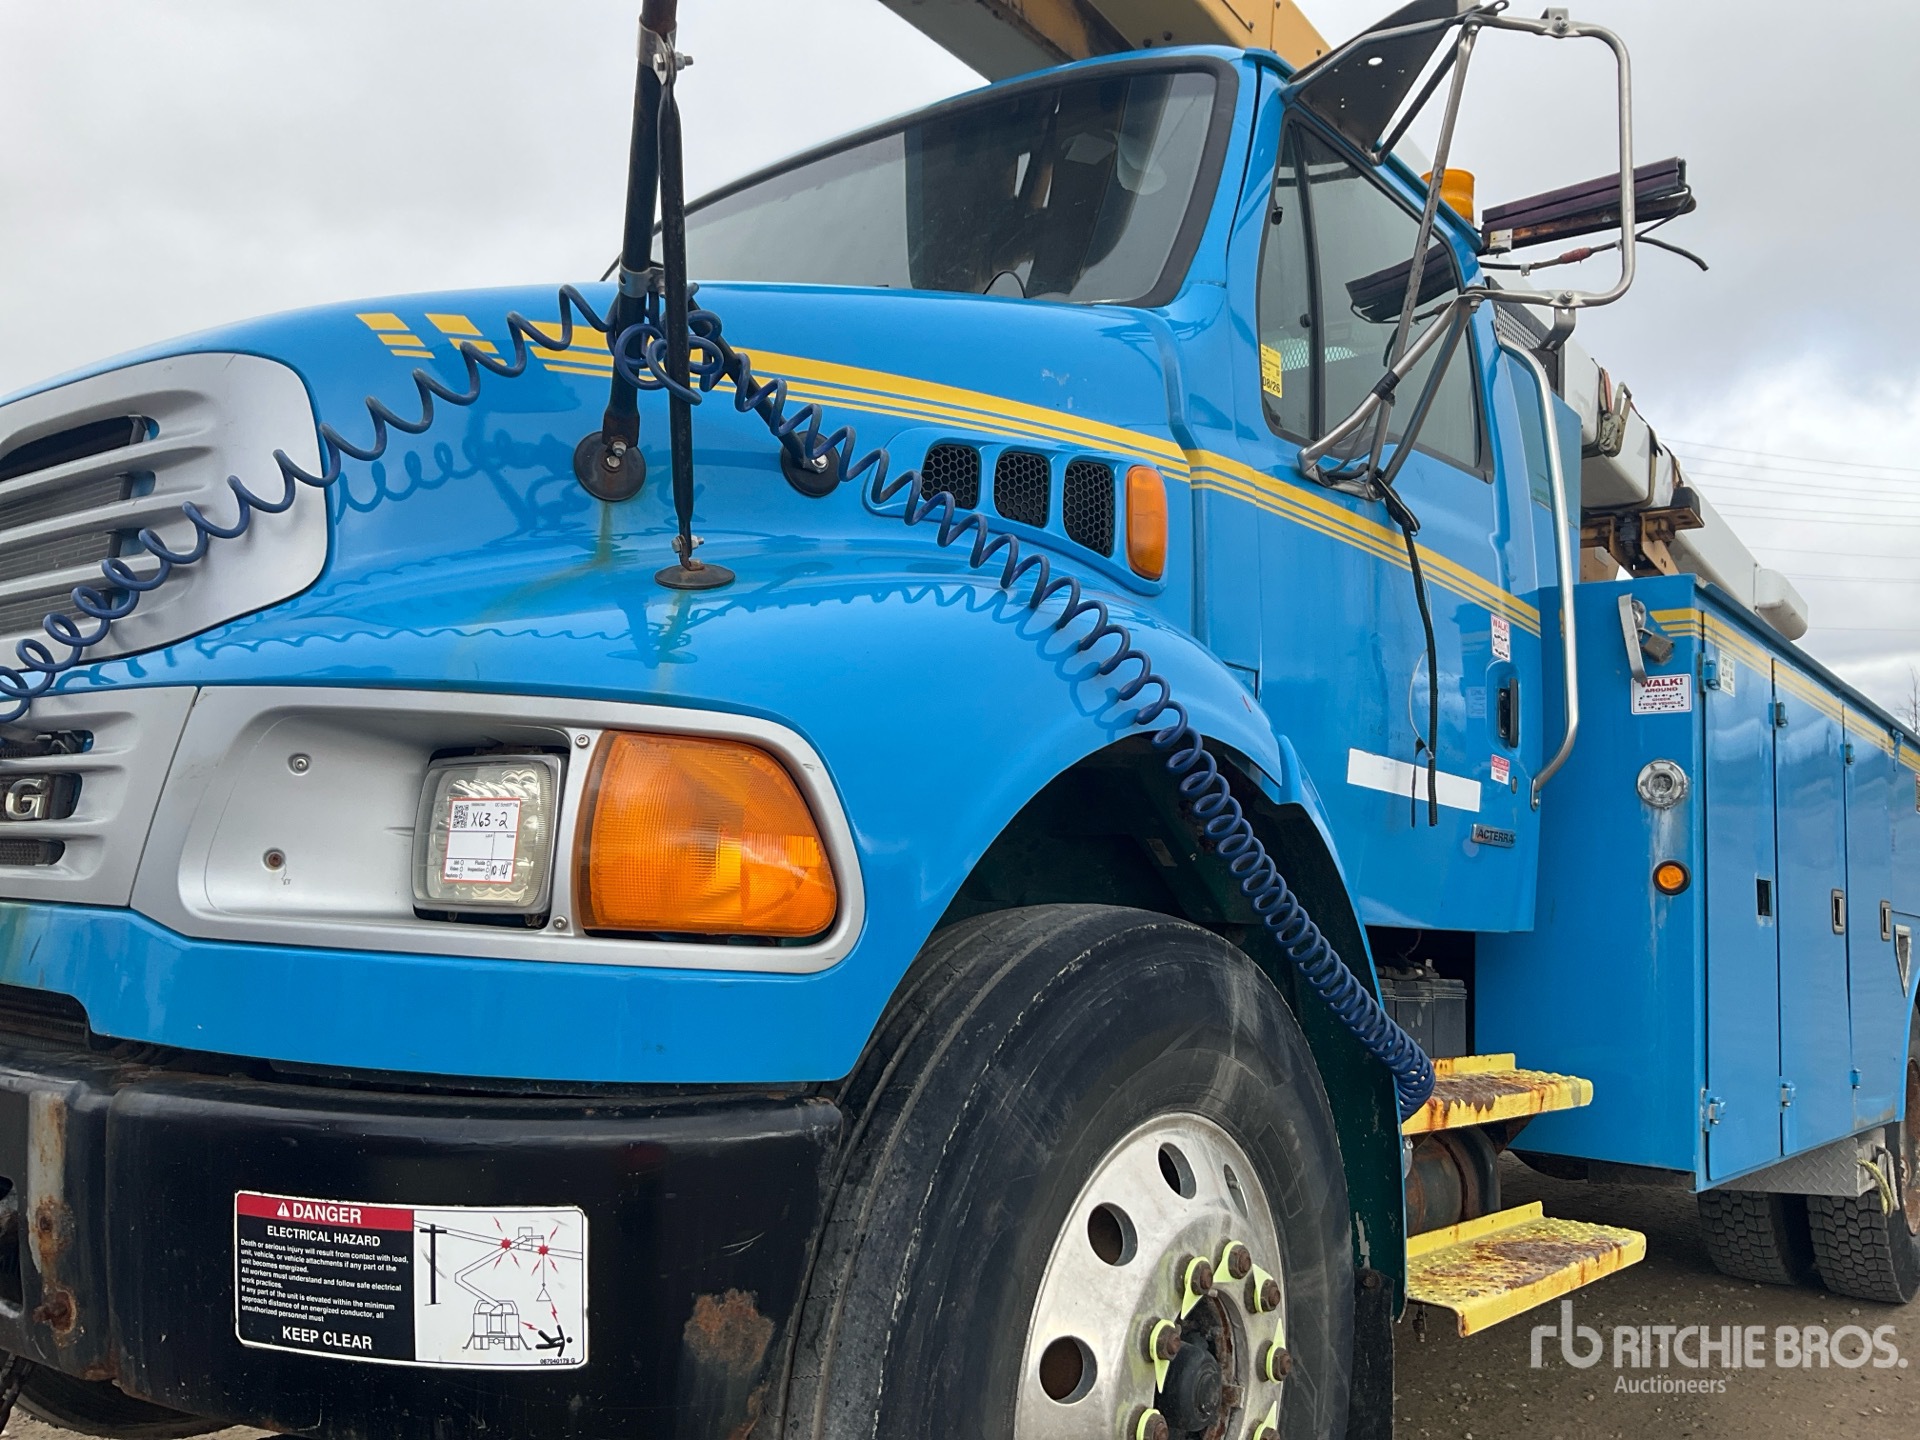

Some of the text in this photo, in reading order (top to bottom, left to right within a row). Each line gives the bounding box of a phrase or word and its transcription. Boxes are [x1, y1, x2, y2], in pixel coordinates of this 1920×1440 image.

[5, 777, 48, 821] G
[1477, 829, 1515, 844] ACTERRA
[293, 1203, 361, 1224] DANGER
[267, 1225, 380, 1246] ELECTRICAL HAZARD
[240, 1238, 256, 1247] Death
[264, 1243, 286, 1251] serious
[286, 1244, 304, 1255] injury
[336, 1250, 350, 1258] from
[352, 1252, 376, 1261] contact
[376, 1254, 390, 1262] with
[392, 1255, 408, 1263] load,
[254, 1250, 274, 1259] vehicle,
[284, 1255, 304, 1263] vehicle
[306, 1257, 342, 1267] attachments
[252, 1259, 278, 1269] becomes
[278, 1264, 308, 1272] energized.
[250, 1269, 272, 1277] workers
[272, 1271, 288, 1279] must
[288, 1274, 322, 1283] understand
[336, 1279, 356, 1287] follow
[372, 1283, 402, 1291] electrical
[256, 1278, 284, 1288] practices.
[242, 1295, 268, 1304] approach
[268, 1298, 292, 1308] distance
[310, 1306, 340, 1314] energized
[340, 1308, 374, 1318] conductor,
[246, 1286, 256, 1294] any
[306, 1295, 332, 1303] elevated
[352, 1299, 364, 1307] the
[364, 1301, 396, 1310] minimum
[242, 1304, 278, 1315] unauthorized
[278, 1310, 308, 1319] personnel
[282, 1326, 372, 1350] KEEP CLEAR
